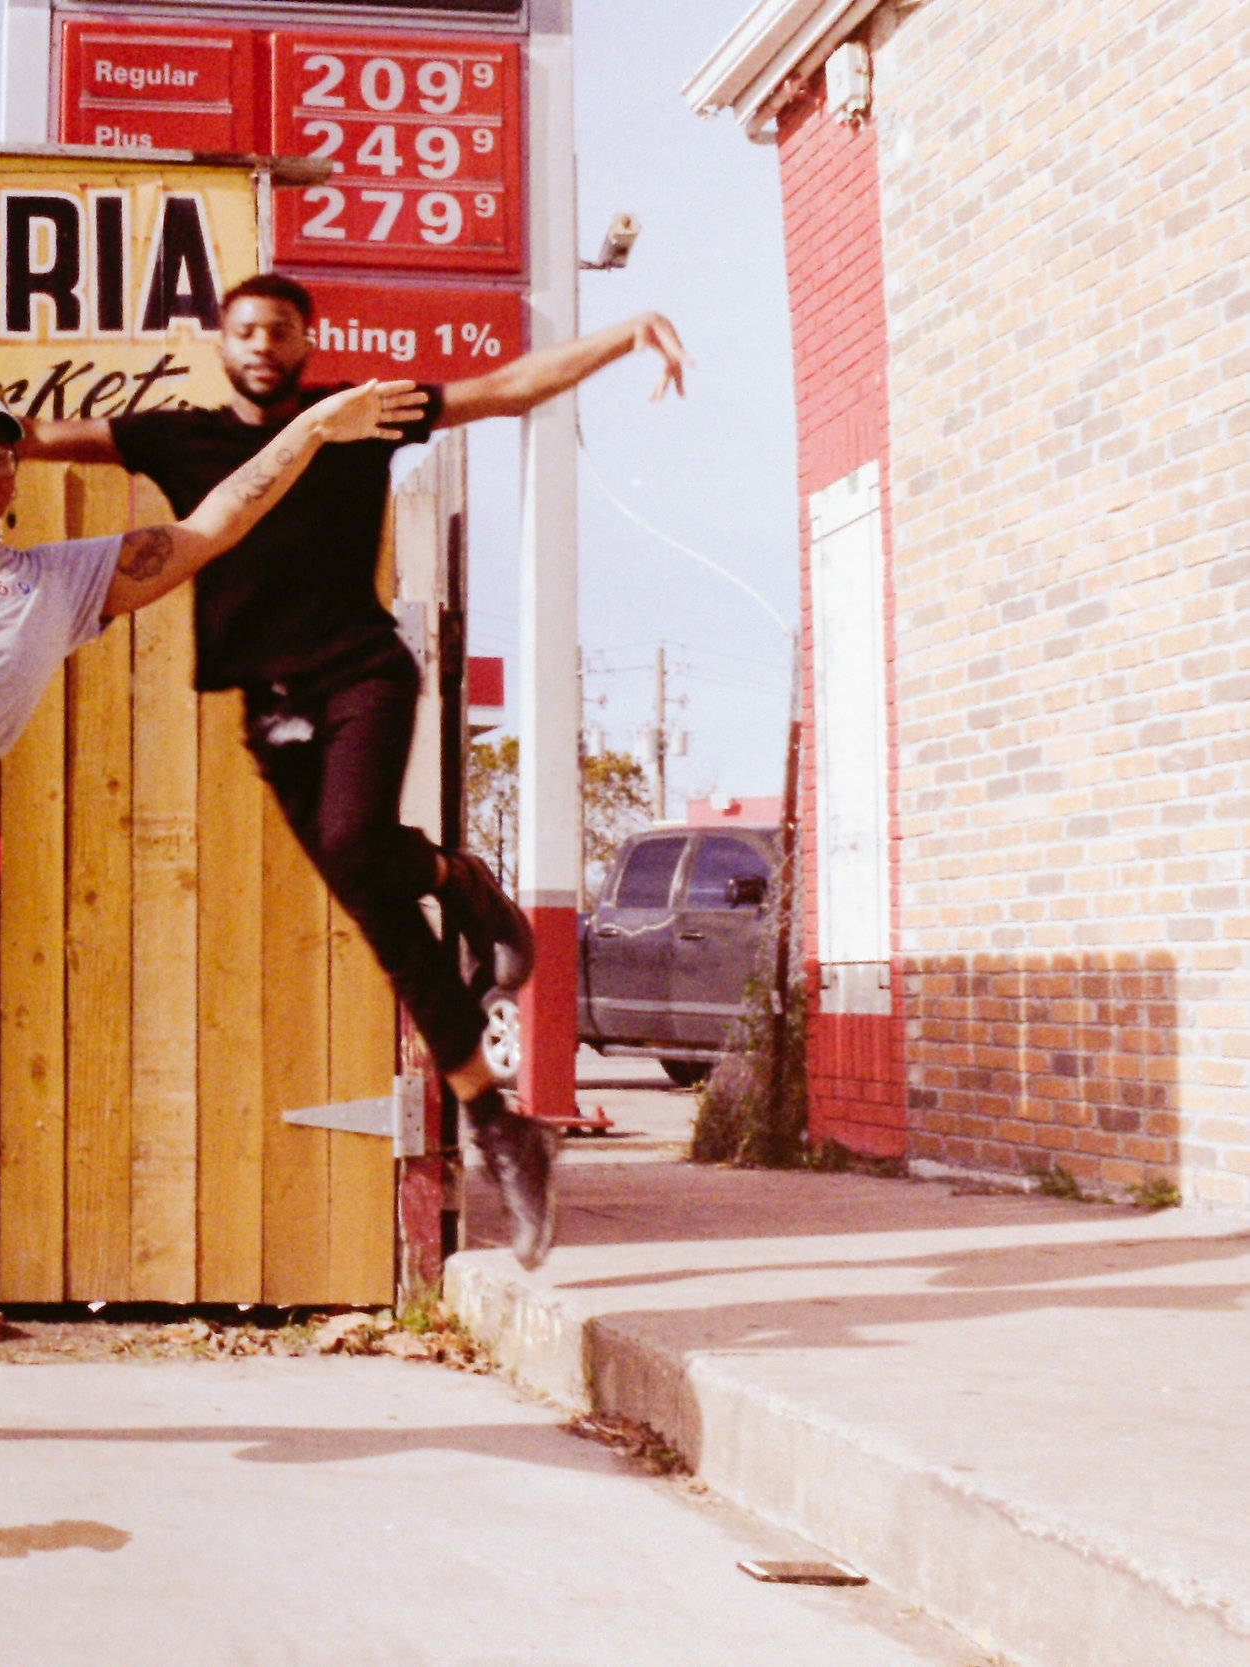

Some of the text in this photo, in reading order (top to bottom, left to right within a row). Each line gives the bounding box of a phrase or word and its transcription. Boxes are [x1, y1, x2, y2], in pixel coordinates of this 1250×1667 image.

[94, 59, 199, 90] Regular
[94, 124, 154, 149] Plus
[434, 322, 501, 358] 1%
